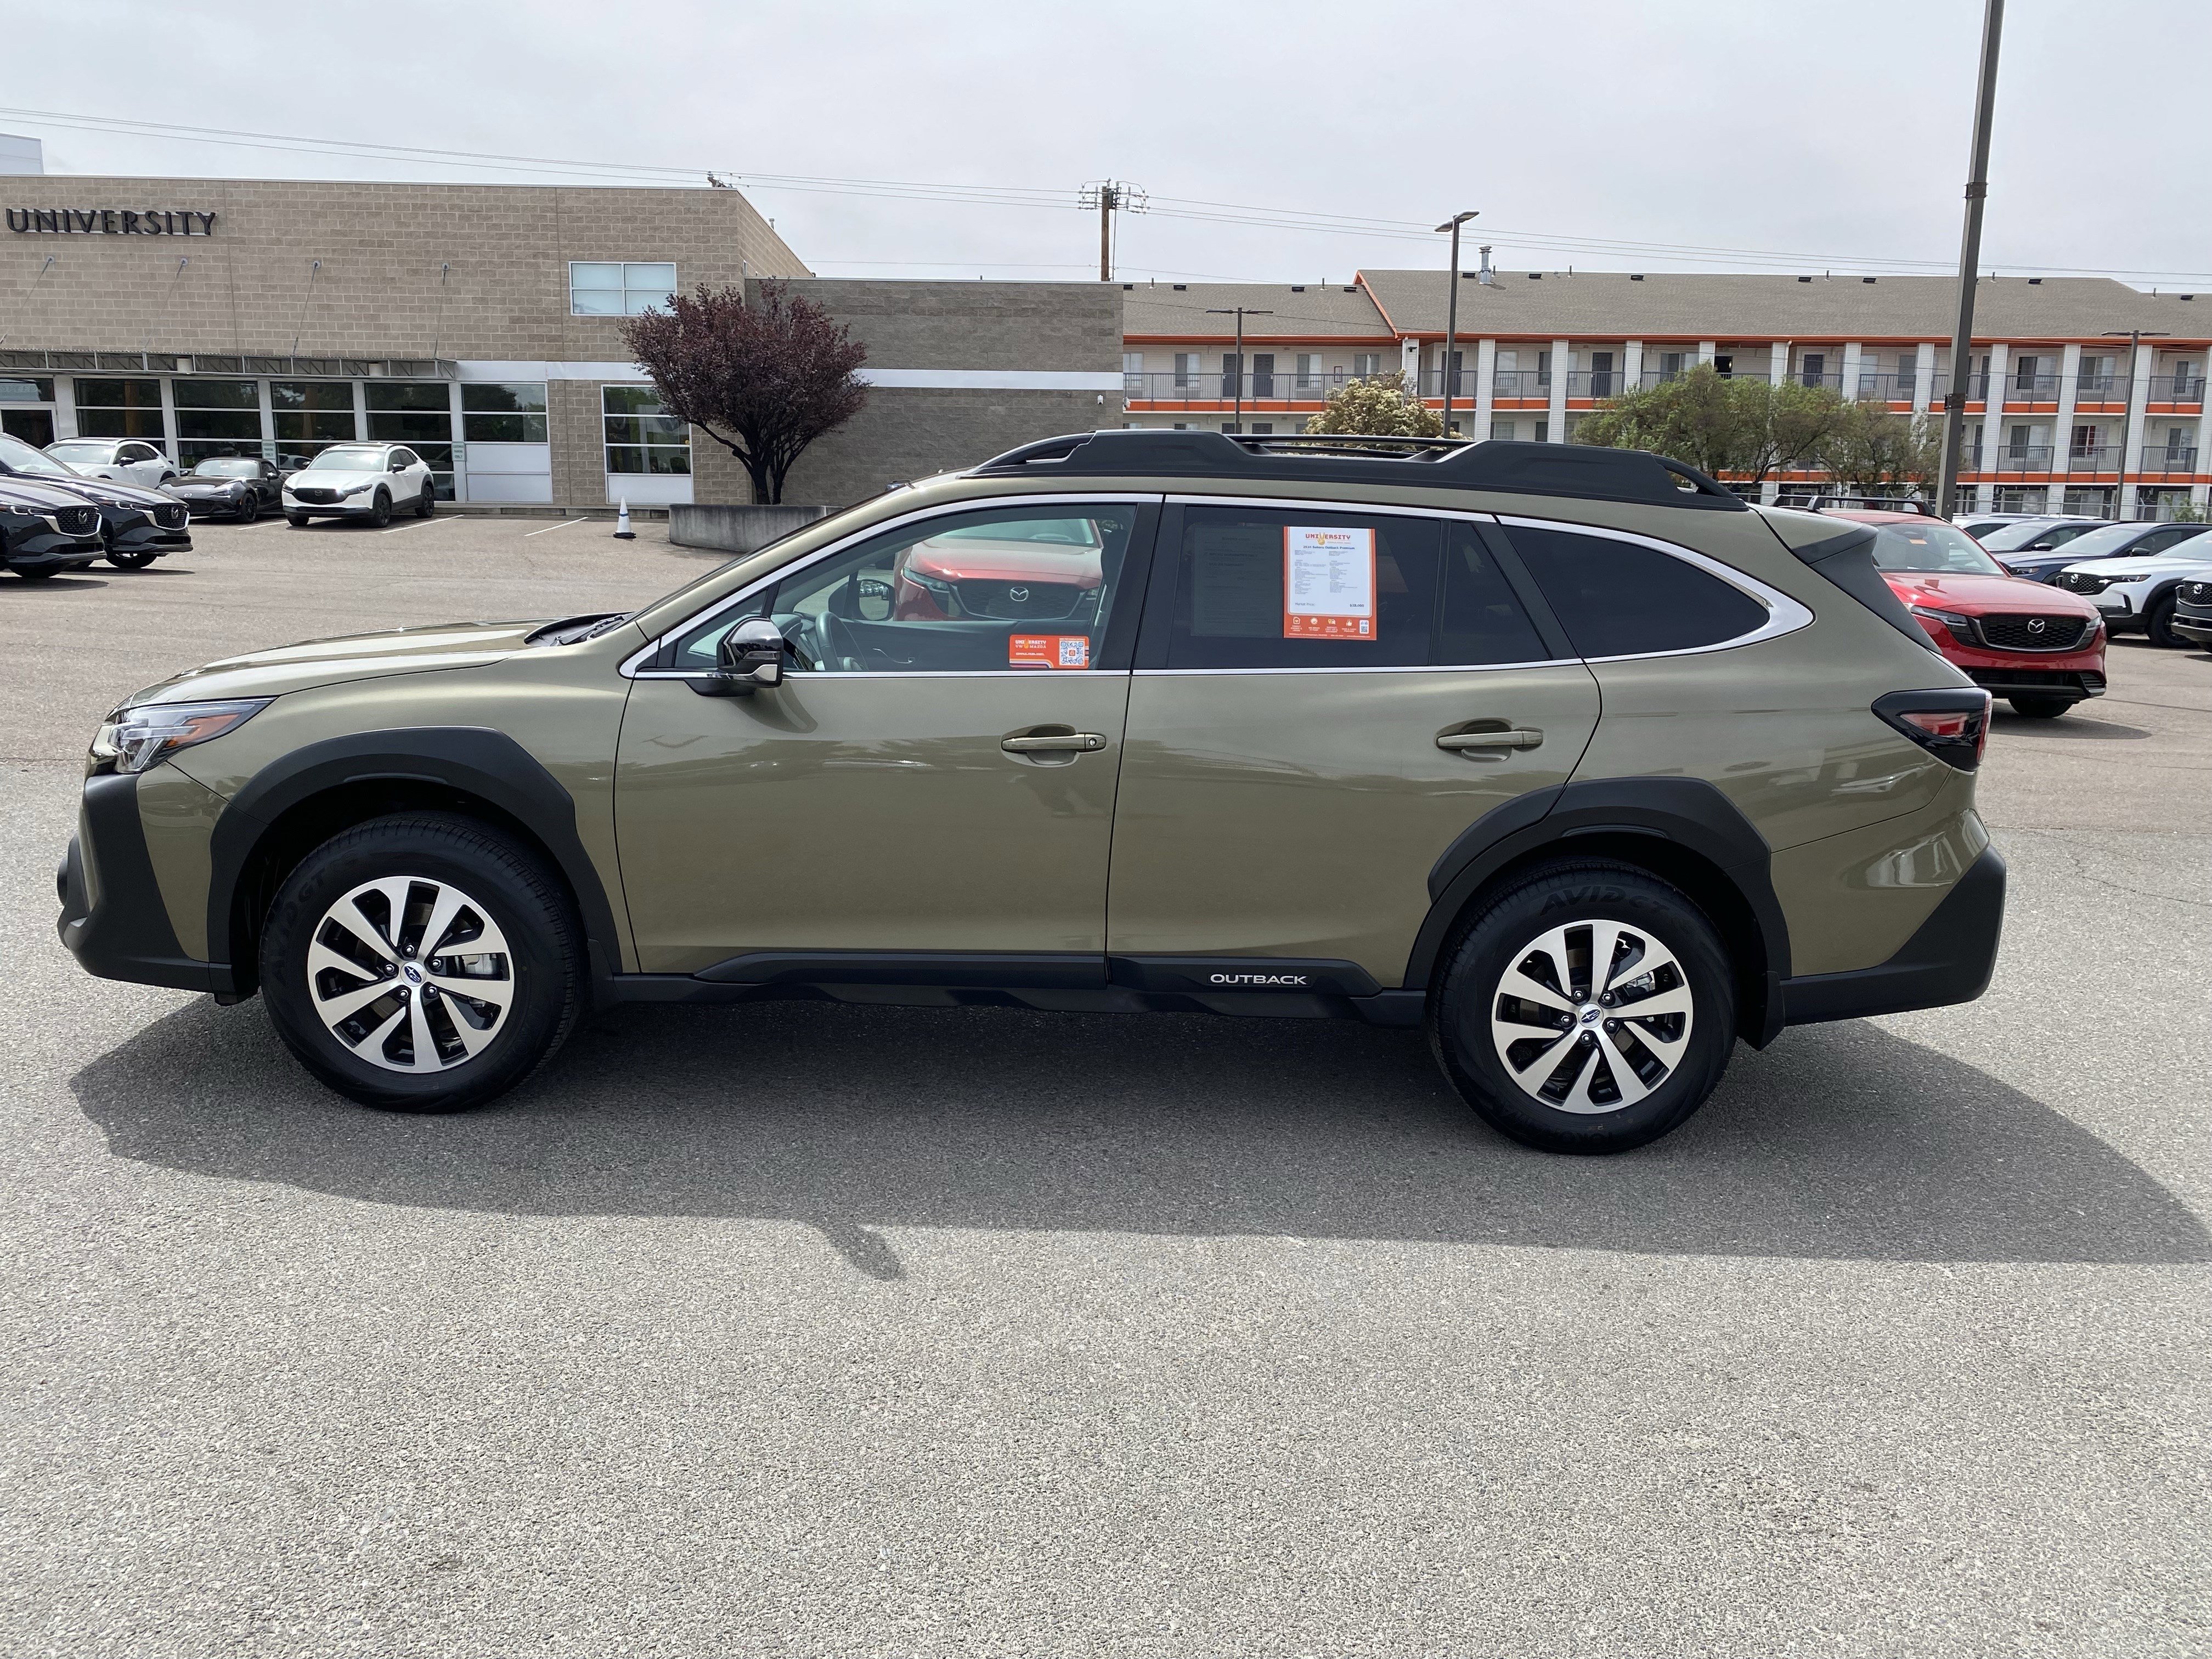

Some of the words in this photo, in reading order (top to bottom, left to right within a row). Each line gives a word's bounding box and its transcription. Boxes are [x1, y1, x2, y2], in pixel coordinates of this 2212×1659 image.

[5, 208, 216, 236] UNIVERSITY
[1539, 886, 1625, 917] AVID
[1210, 974, 1308, 985] OUTBACK
